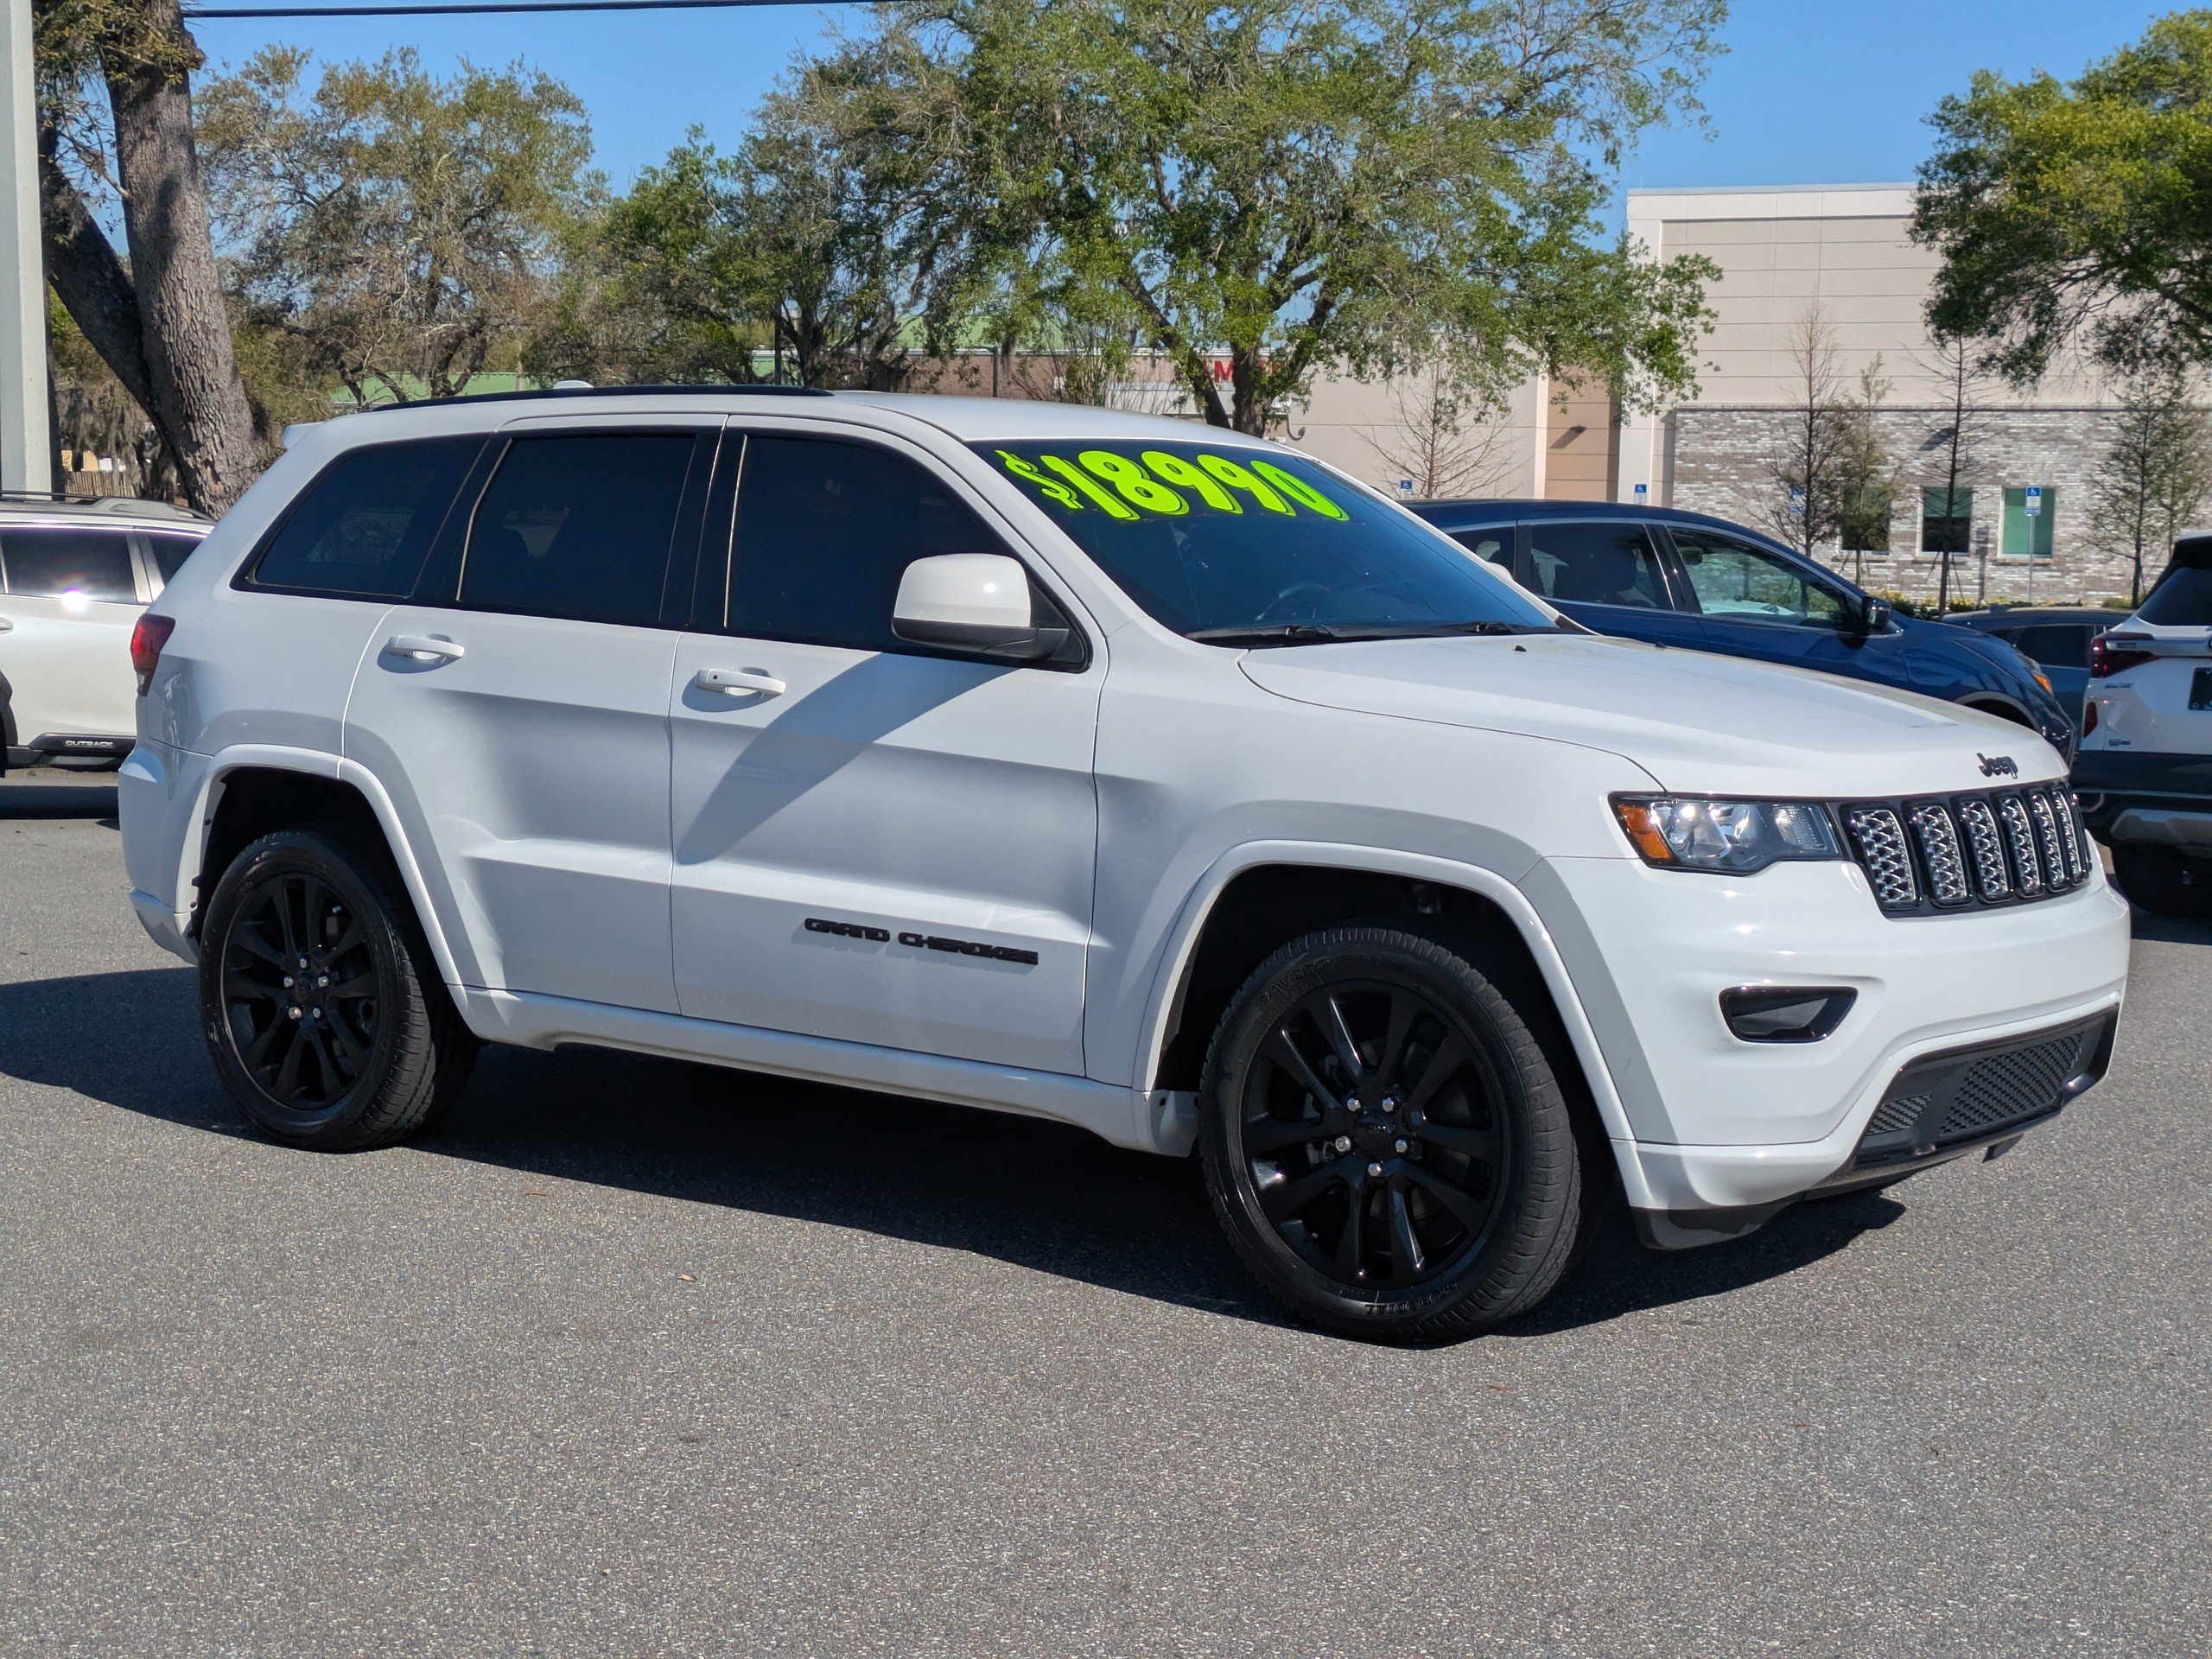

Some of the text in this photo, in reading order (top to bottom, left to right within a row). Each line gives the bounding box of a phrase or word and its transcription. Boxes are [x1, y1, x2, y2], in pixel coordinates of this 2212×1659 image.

[995, 449, 1350, 521] $18990
[1976, 753, 2018, 779] Jeep
[804, 917, 1039, 965] GRAND CHEROKEE
